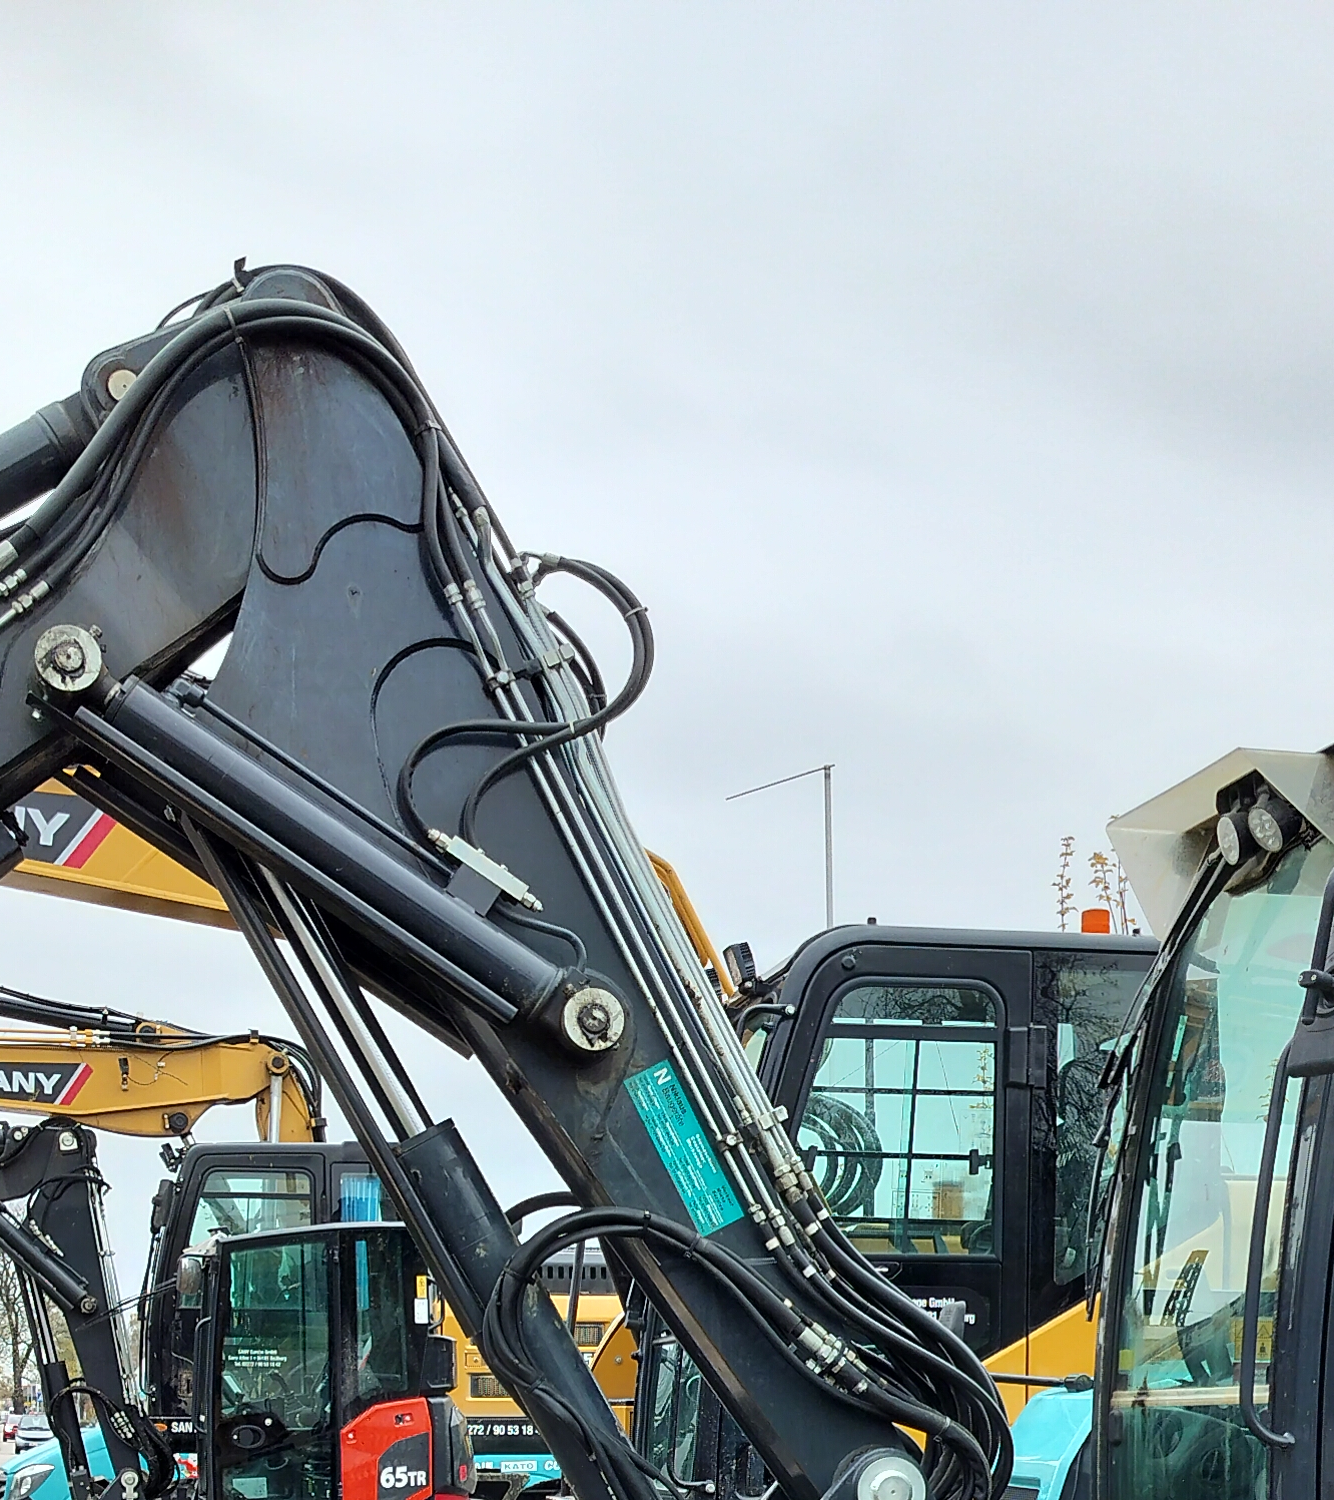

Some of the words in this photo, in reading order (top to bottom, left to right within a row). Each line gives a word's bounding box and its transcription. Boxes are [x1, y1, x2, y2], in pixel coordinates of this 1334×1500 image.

[653, 1067, 672, 1086] N
[170, 1421, 197, 1434] SAN
[493, 1424, 506, 1436] 90
[507, 1424, 520, 1436] 53
[380, 1465, 427, 1489] 65TR
